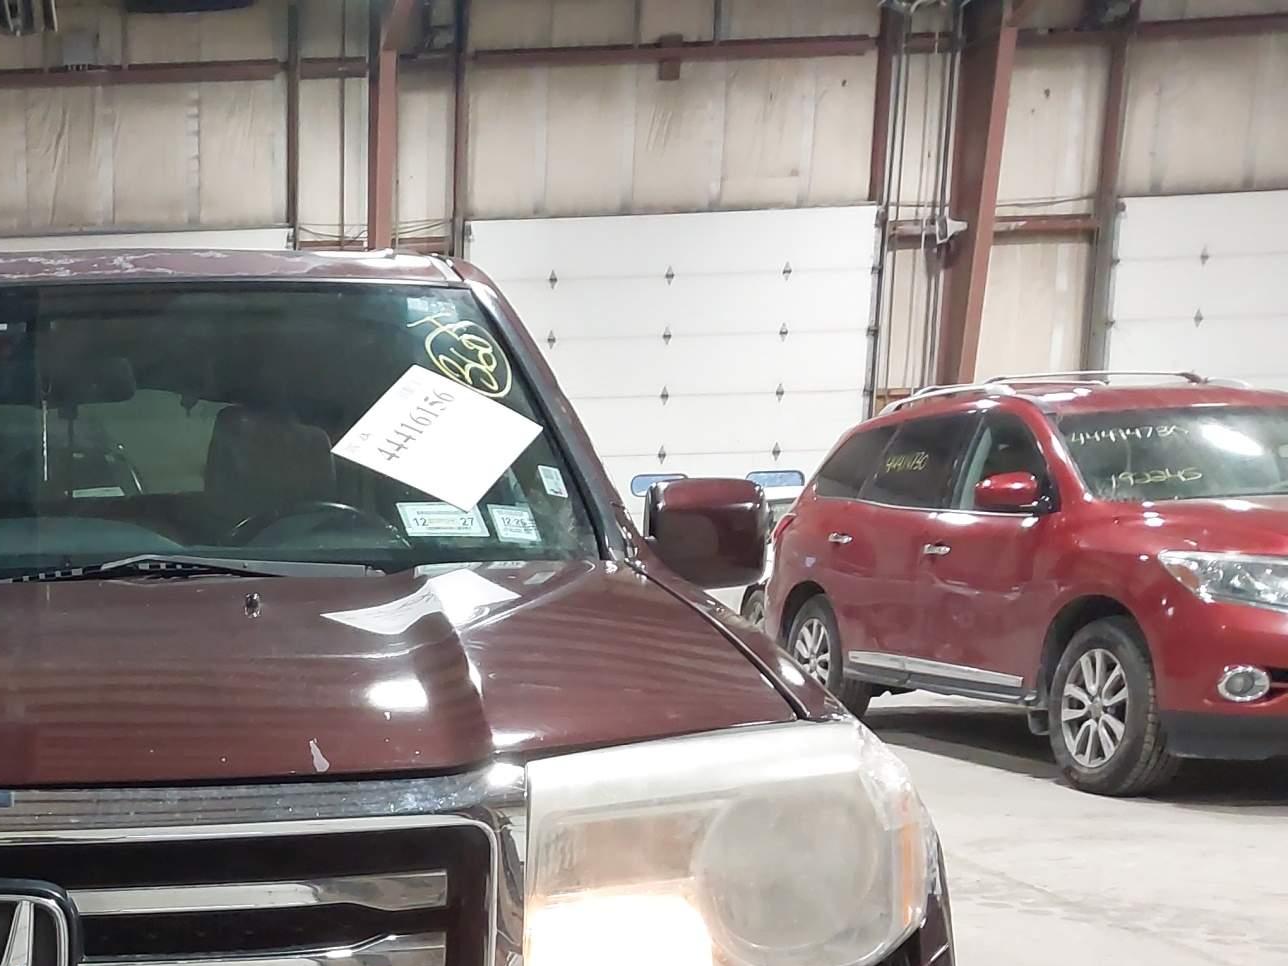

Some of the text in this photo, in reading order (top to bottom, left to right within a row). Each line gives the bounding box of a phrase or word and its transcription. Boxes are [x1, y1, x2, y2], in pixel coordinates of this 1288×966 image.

[376, 388, 455, 461] 44416156
[413, 516, 475, 527] 12 27
